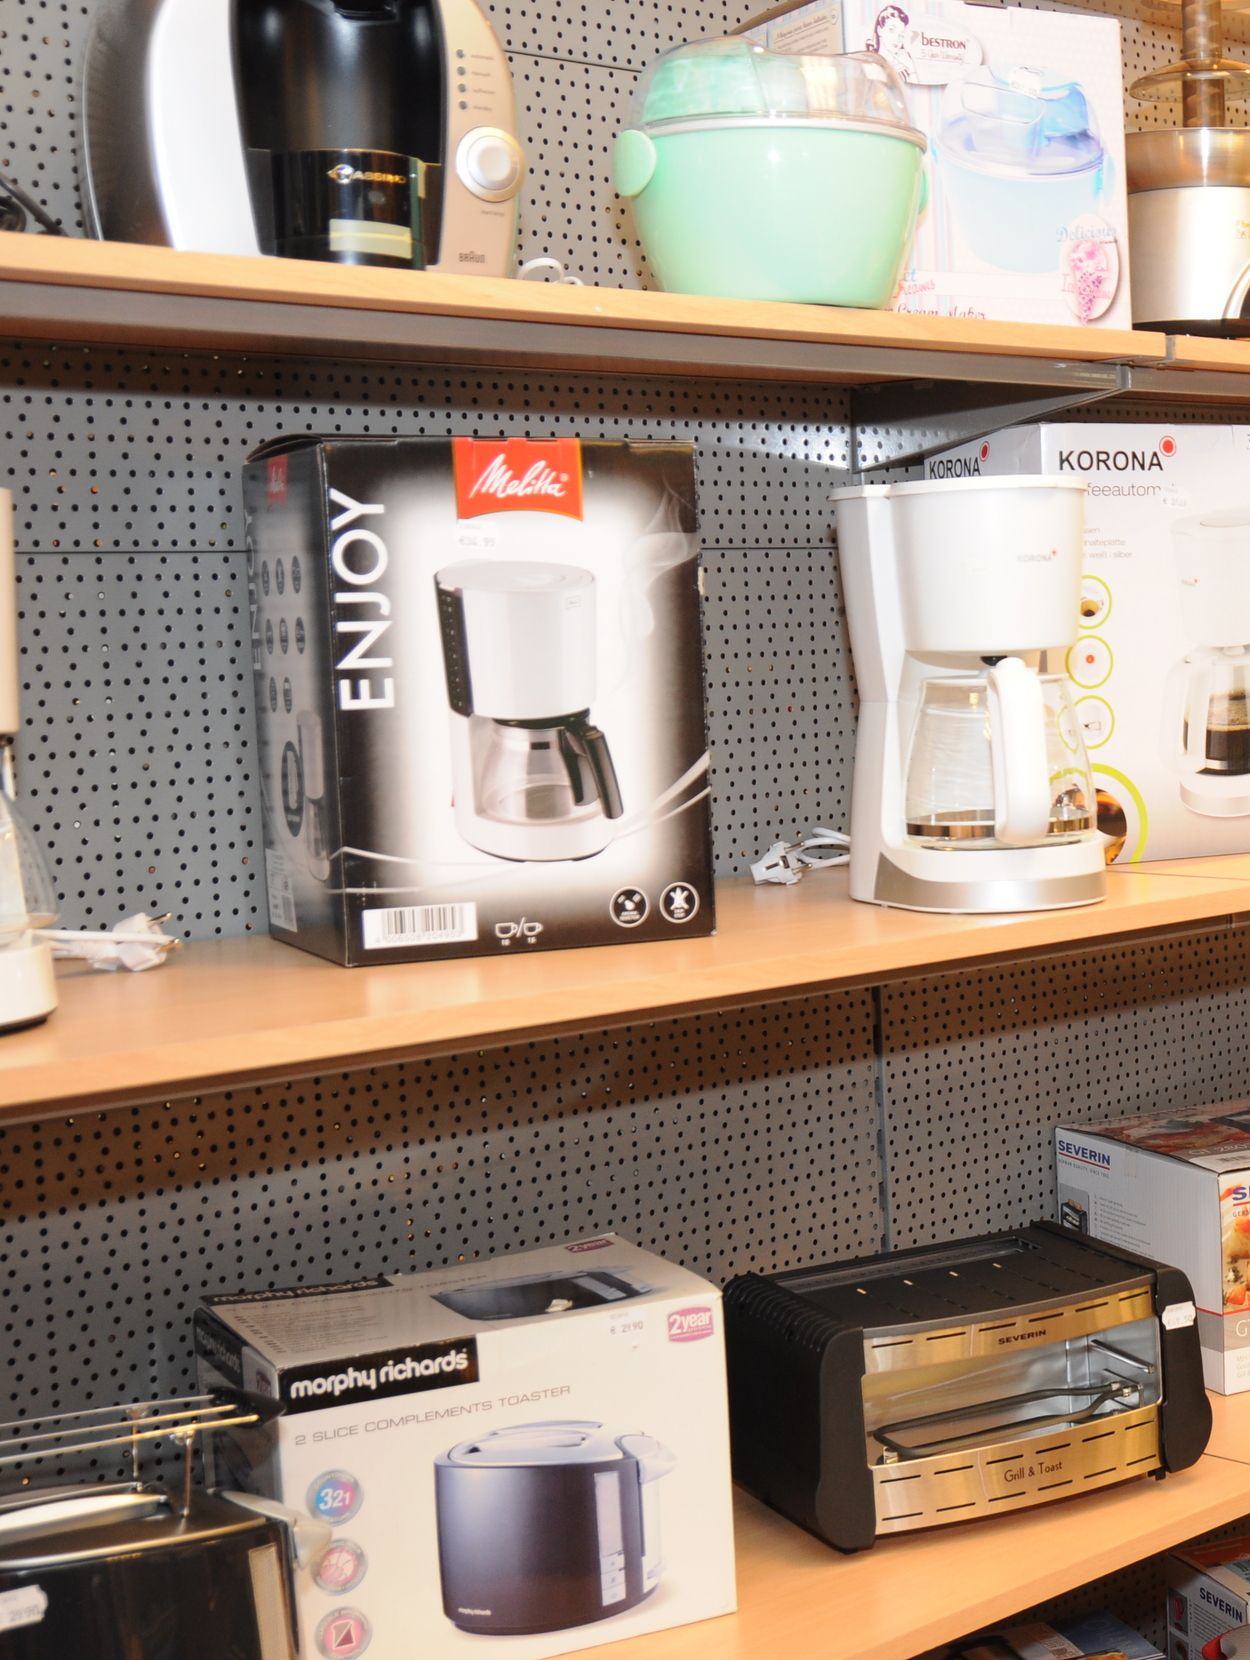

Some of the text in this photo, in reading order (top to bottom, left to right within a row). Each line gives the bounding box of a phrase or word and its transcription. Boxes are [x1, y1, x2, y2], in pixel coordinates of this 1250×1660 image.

[929, 457, 981, 479] KORONA
[1058, 450, 1164, 472] KORONA
[469, 453, 567, 498] Melitta
[1087, 482, 1161, 497] feeautom
[330, 487, 395, 711] ENJOY
[1058, 1140, 1111, 1166] SEVERIN
[998, 1329, 1047, 1345] SEVERIN
[290, 1349, 469, 1399] morphy richards
[295, 1385, 571, 1446] 2 SLICE COMPLEMENTS TOASTER
[1004, 1460, 1063, 1482] Grill & Toast
[1200, 1587, 1243, 1623] SEVERIN
